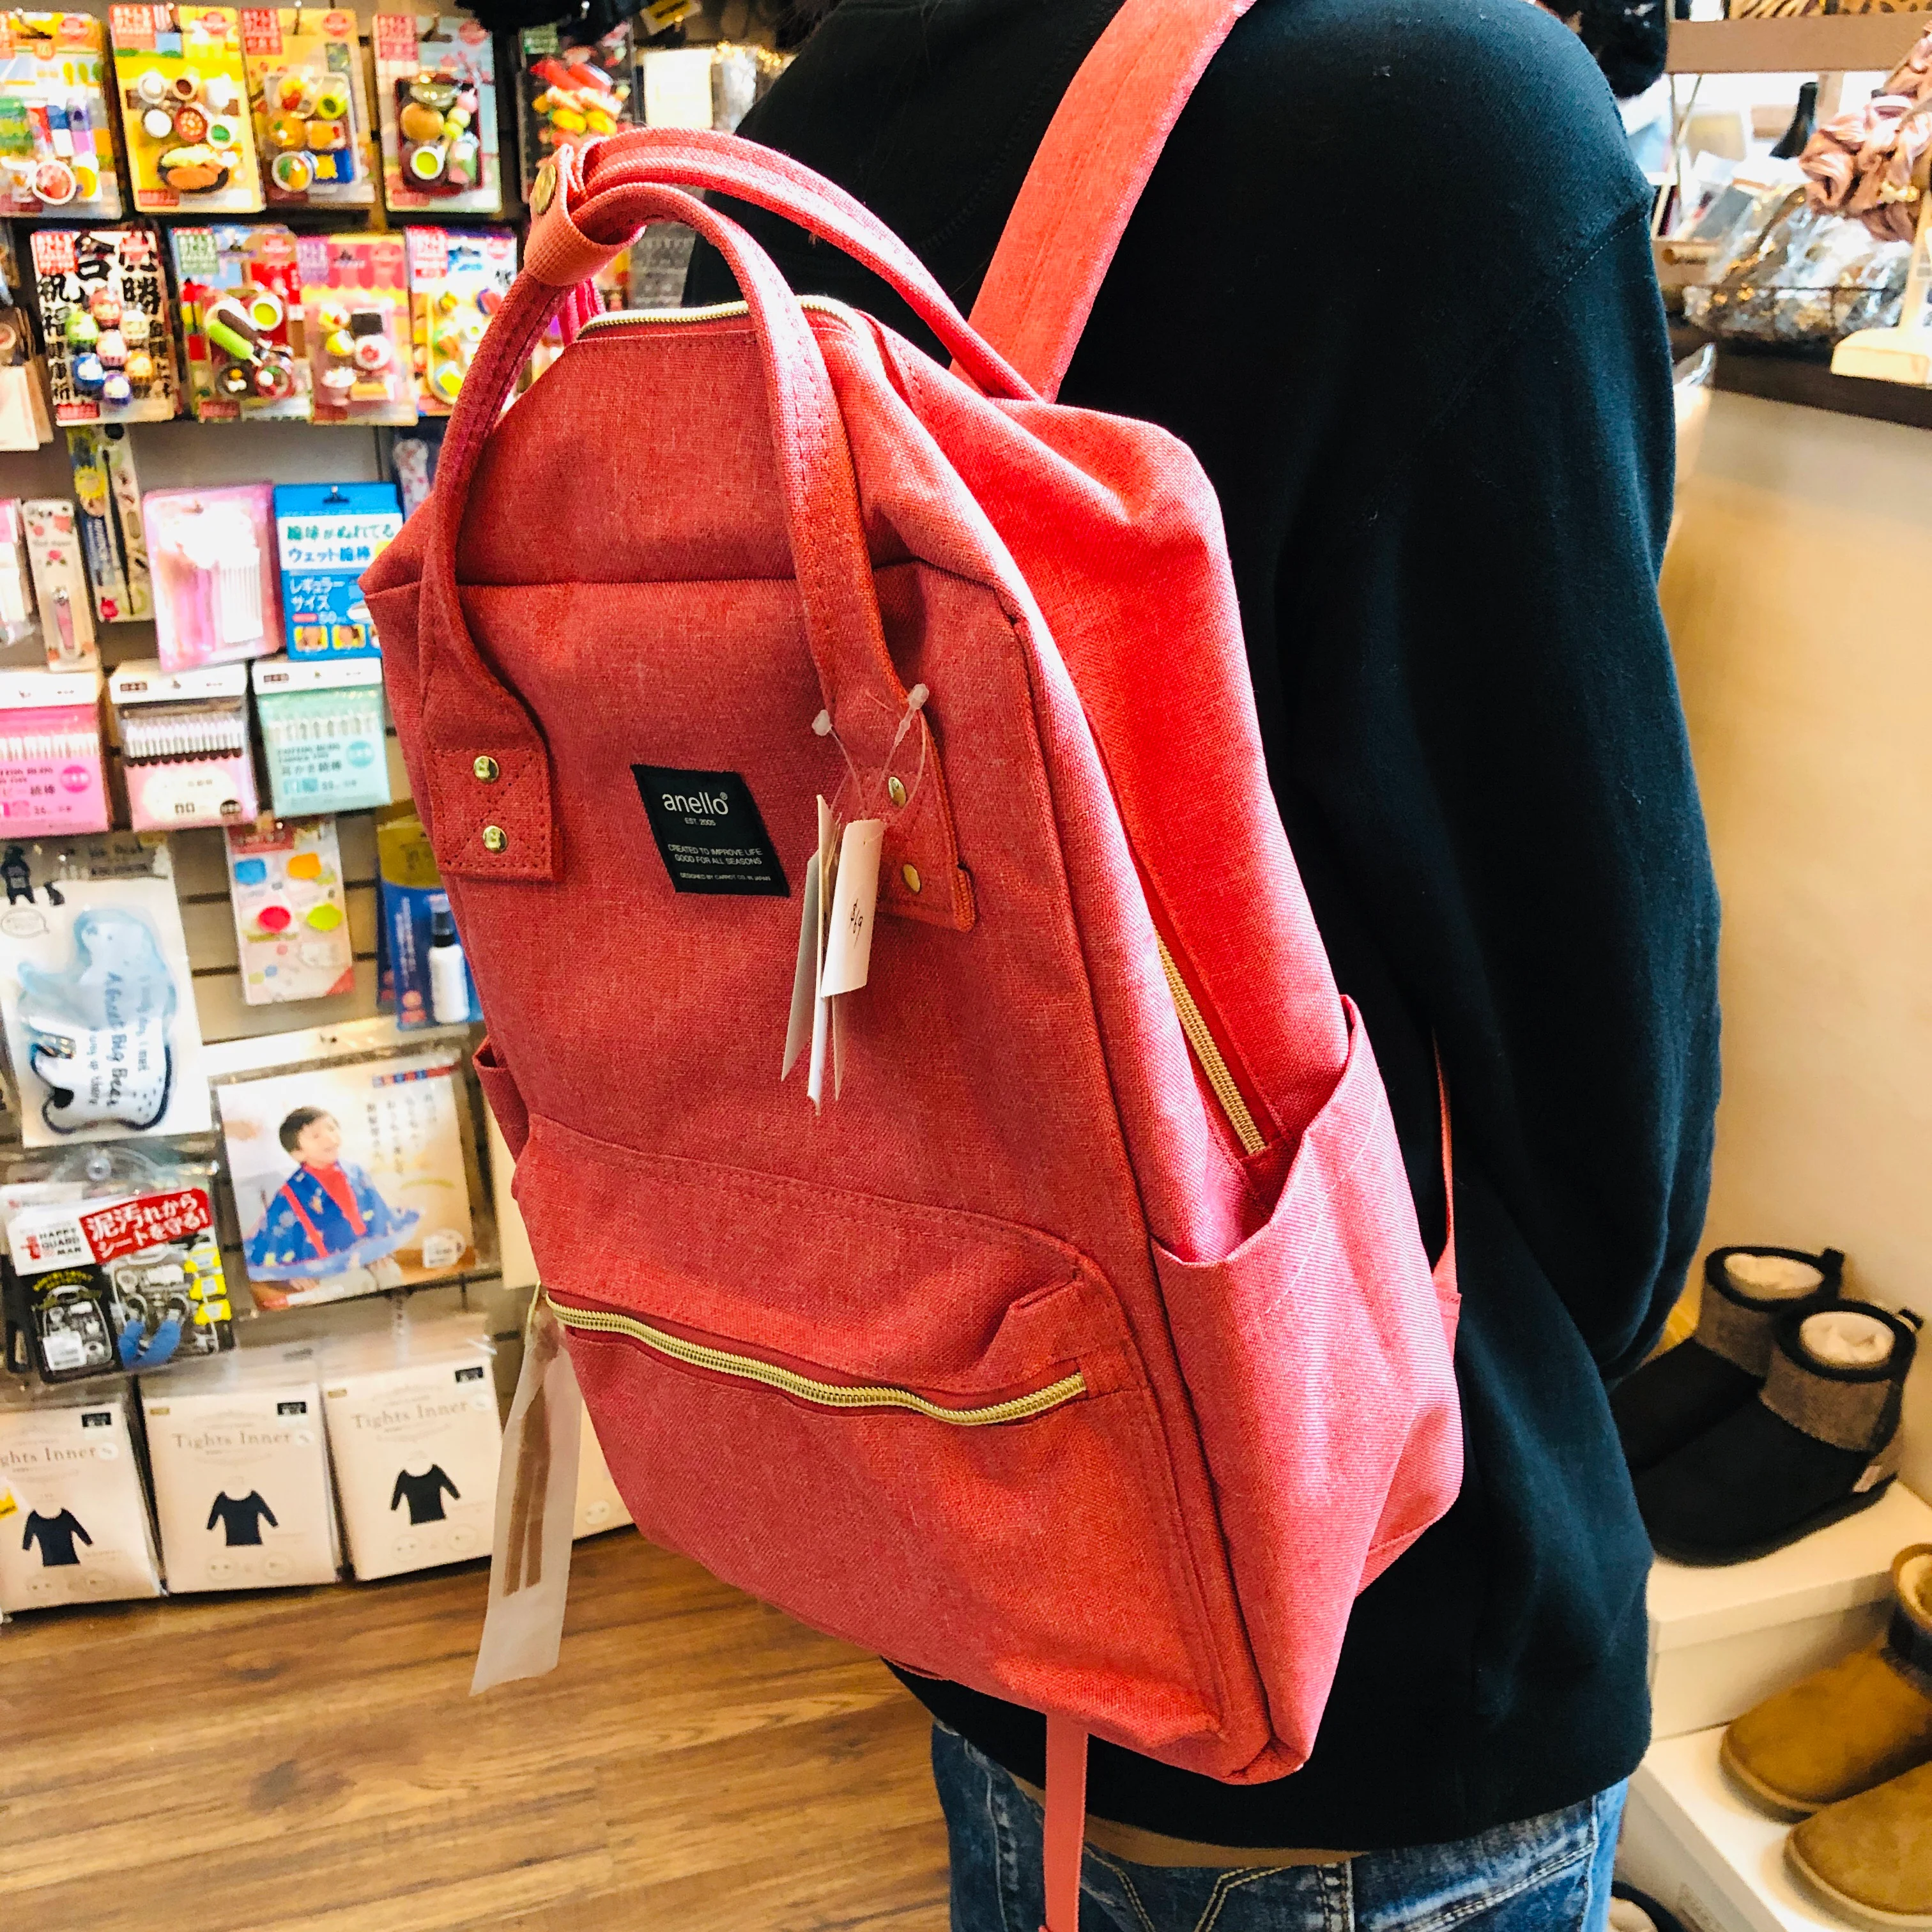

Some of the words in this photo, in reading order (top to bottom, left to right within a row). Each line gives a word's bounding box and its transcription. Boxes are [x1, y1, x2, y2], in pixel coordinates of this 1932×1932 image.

[662, 792, 728, 815] anello
[668, 843, 699, 854] CREATED
[699, 847, 710, 855] TO
[710, 848, 745, 857] IMPROVE
[744, 848, 763, 856] LIFE
[675, 854, 696, 863] GOOD
[696, 856, 711, 864] FOR
[725, 857, 763, 866] SEASONS
[85, 1193, 197, 1242] 泥汚れから
[39, 1227, 77, 1239] HAPPY
[41, 1236, 80, 1250] GUARD
[57, 1246, 82, 1255] MAN
[350, 1409, 411, 1430] Tights
[416, 1402, 468, 1420] Inner
[172, 1430, 233, 1449] Tights
[239, 1430, 290, 1445] Inner
[45, 1446, 96, 1462] Inner
